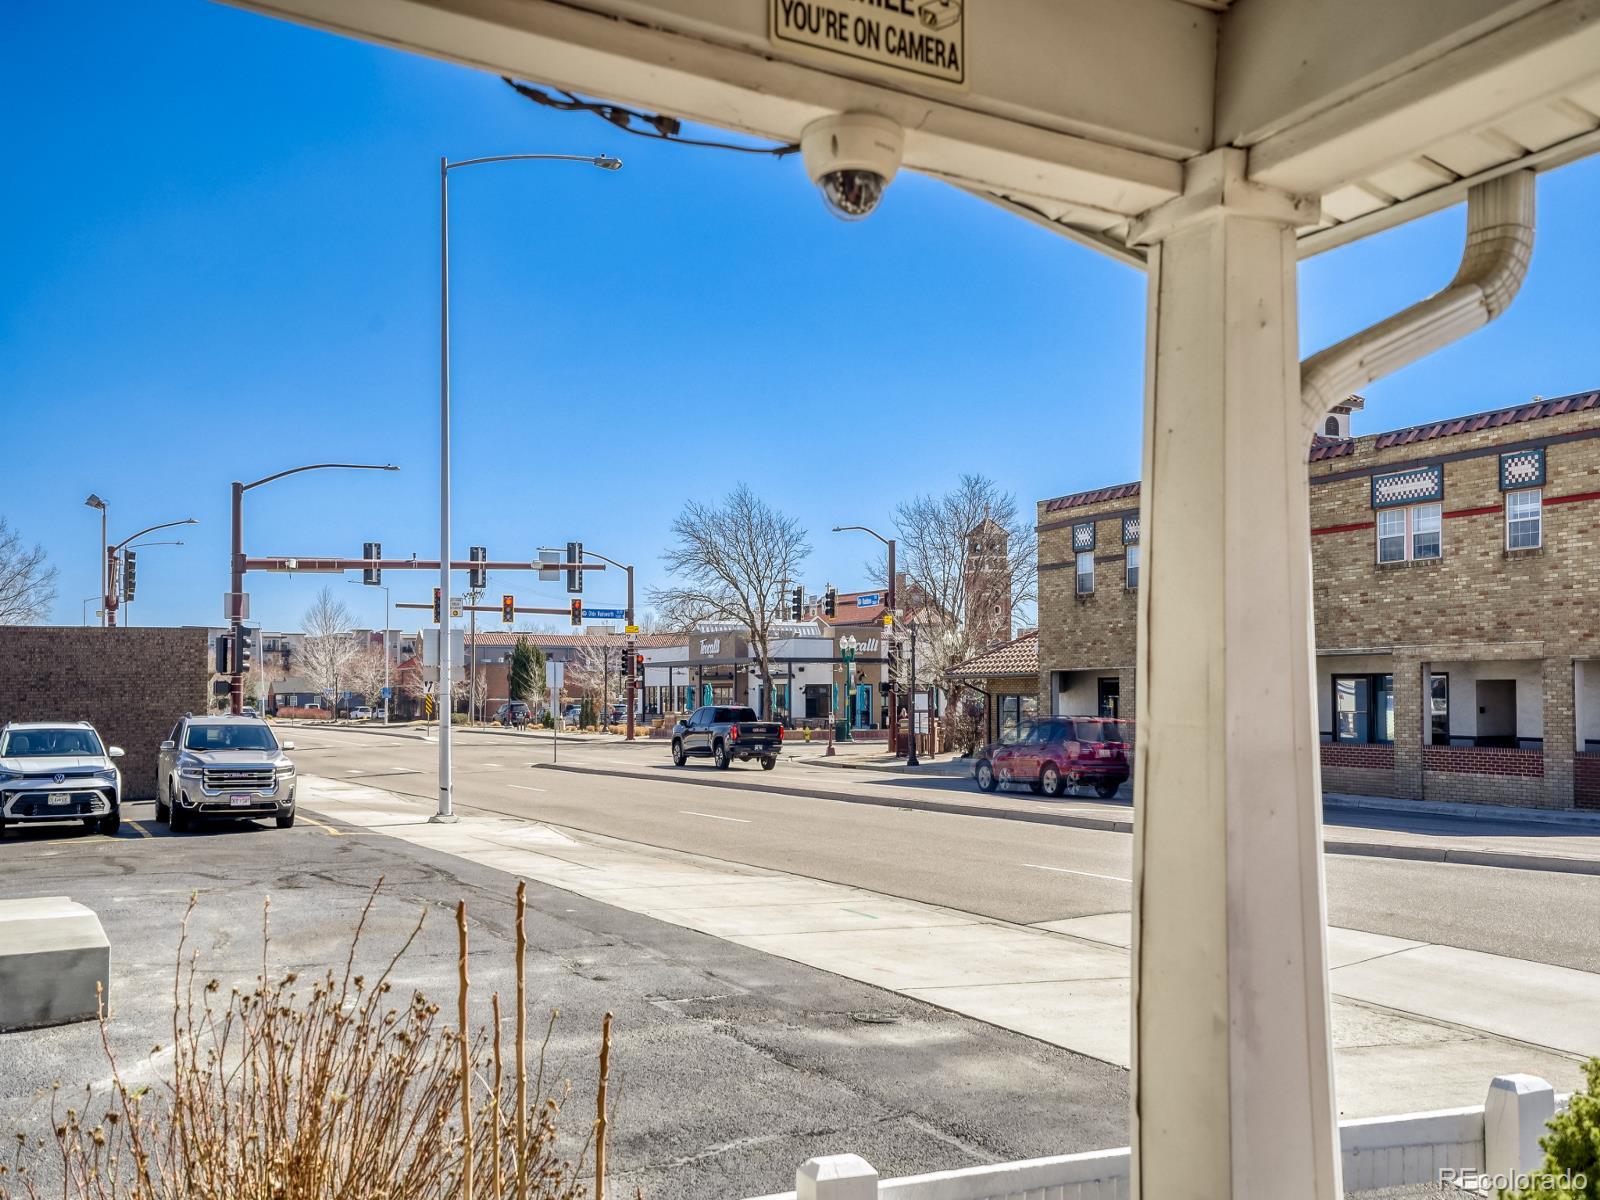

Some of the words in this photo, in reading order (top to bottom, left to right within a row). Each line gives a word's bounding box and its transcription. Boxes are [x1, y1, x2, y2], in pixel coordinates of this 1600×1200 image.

[780, 0, 849, 42] YOU'RE
[854, 17, 881, 51] ON
[885, 26, 960, 72] CAMERA
